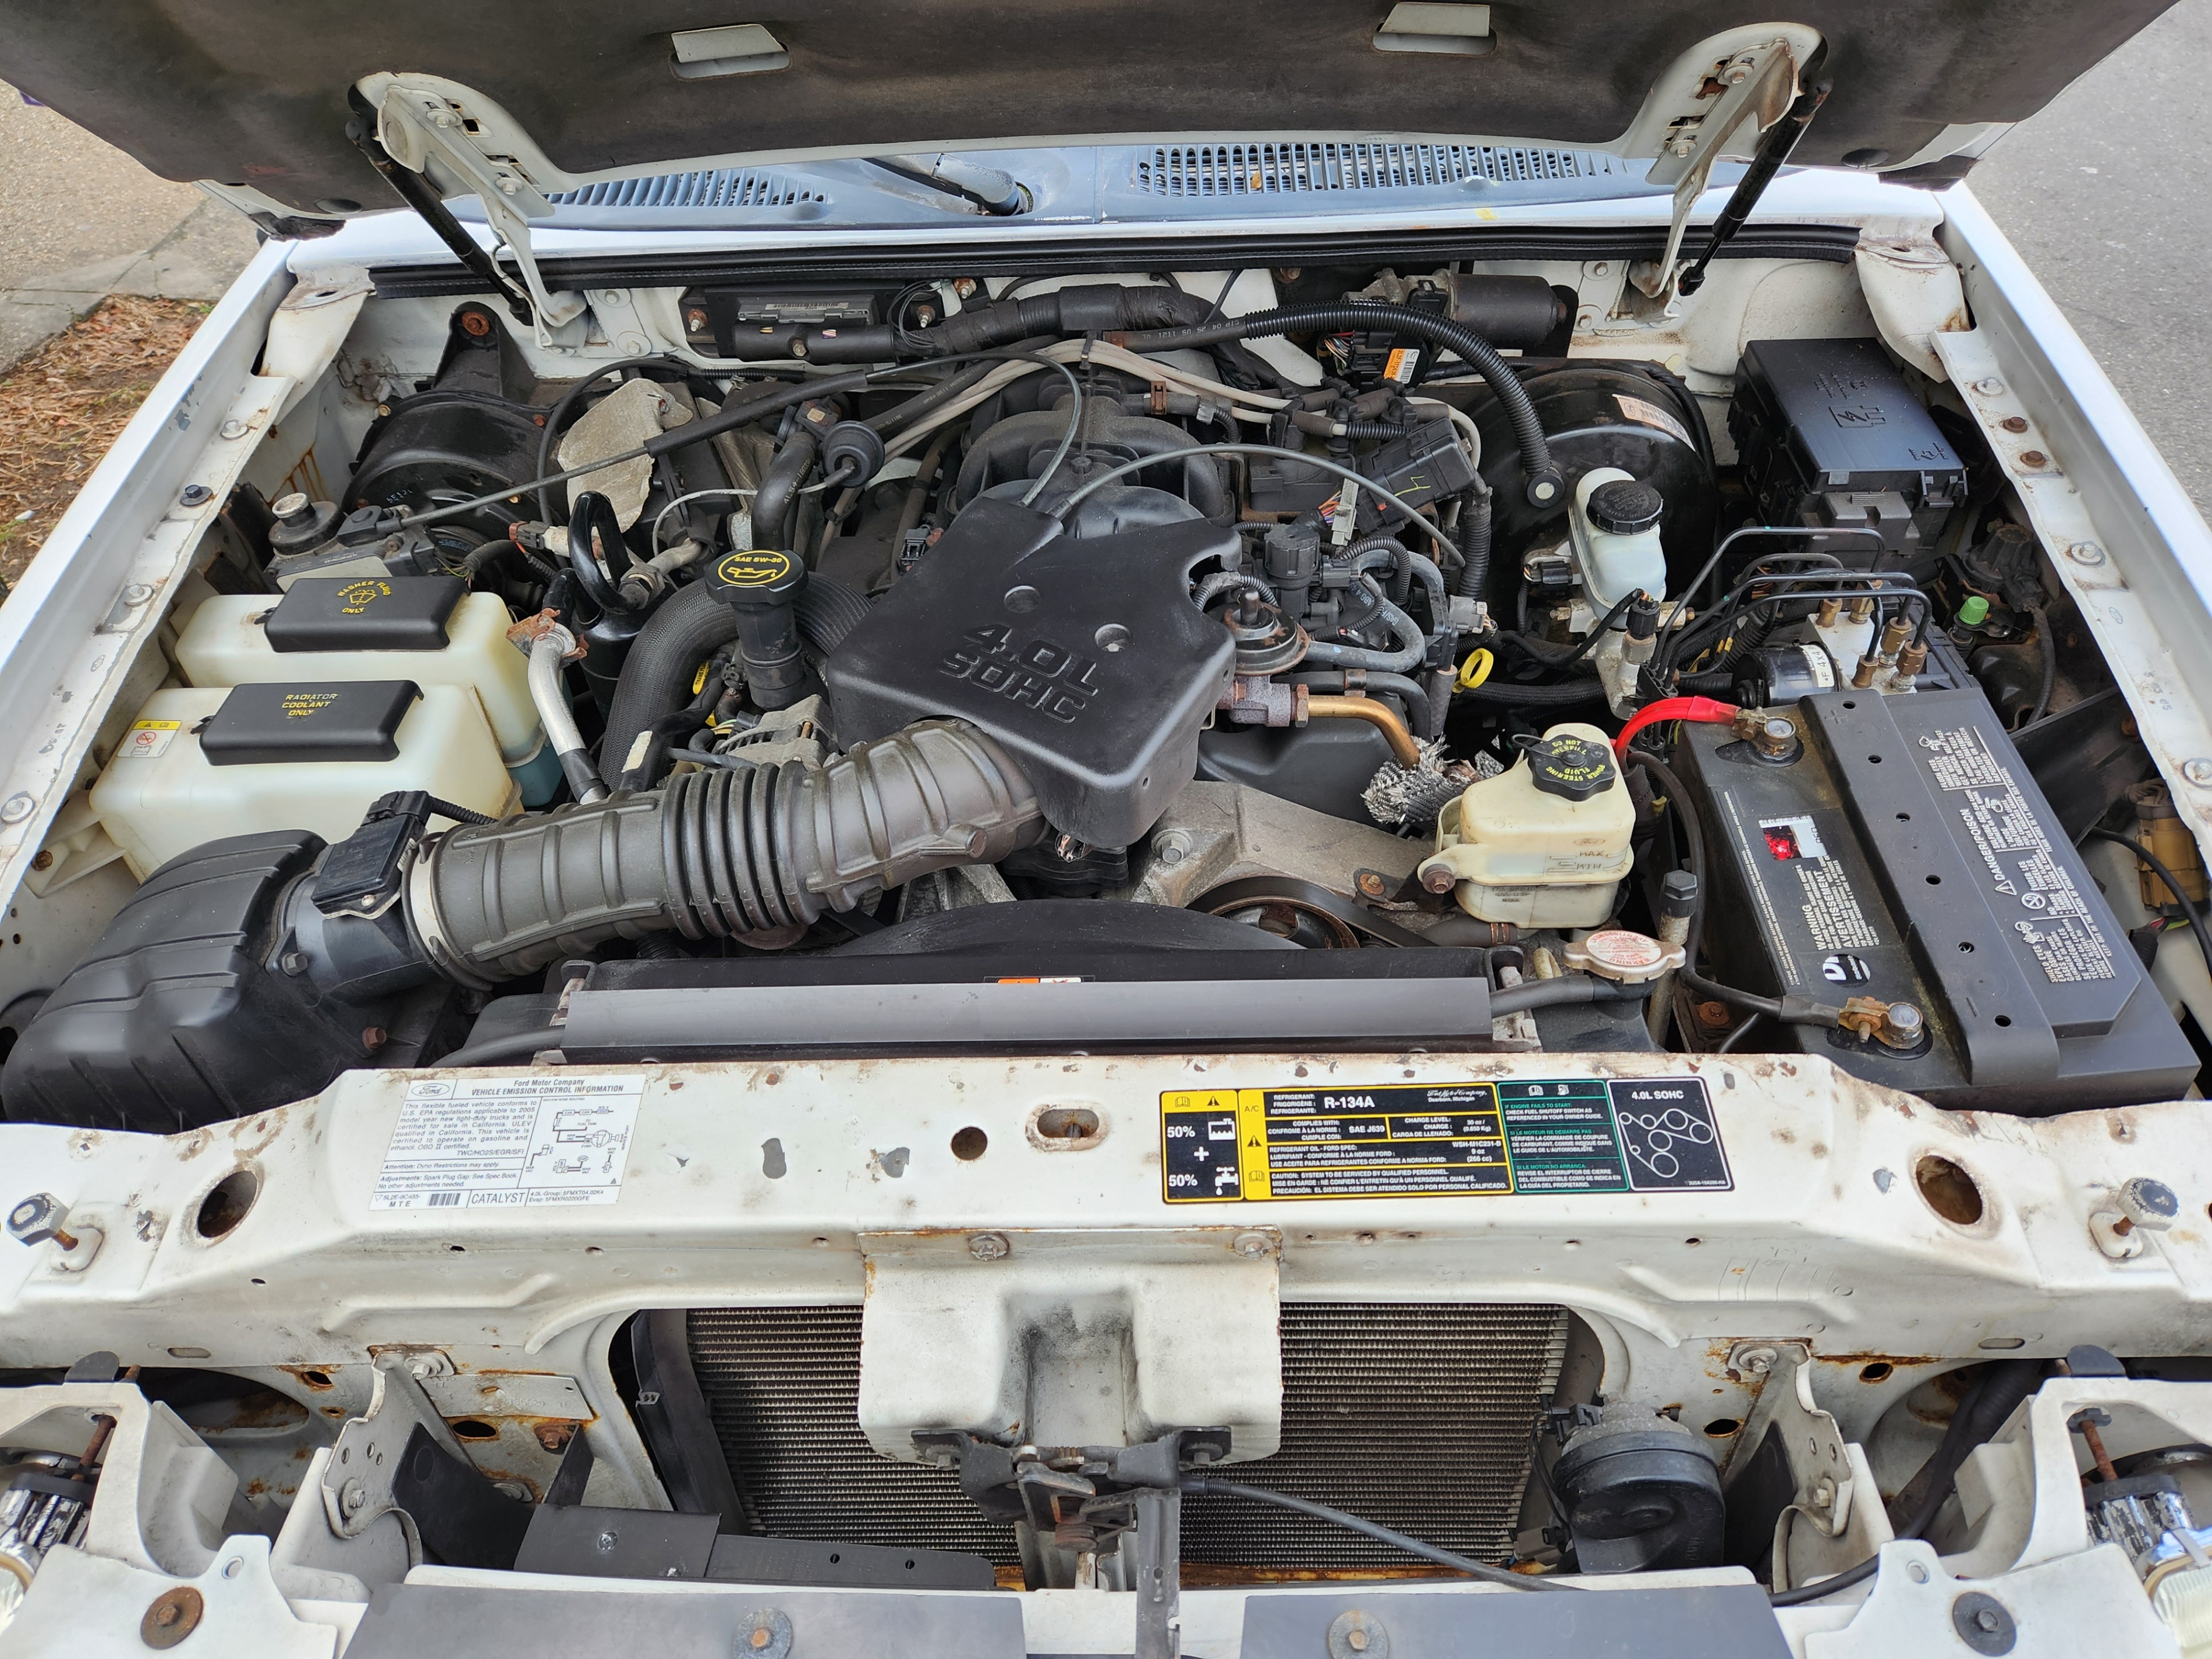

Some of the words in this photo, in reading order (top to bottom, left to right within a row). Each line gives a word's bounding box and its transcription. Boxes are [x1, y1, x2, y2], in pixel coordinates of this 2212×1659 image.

[337, 581, 374, 597] WASHER
[377, 582, 391, 595] FLUID
[962, 623, 1099, 697] 4.0L
[935, 648, 1086, 723] SOHC
[1586, 764, 1605, 779] POWER
[1927, 759, 1939, 771] EYES
[1546, 766, 1583, 781] STEERING
[1934, 772, 1948, 788] FLUSH
[1958, 809, 2005, 881] DANGER/POISON
[1813, 870, 1853, 947] AVERTISSEMENT
[1801, 904, 1827, 950] WARNING
[2031, 944, 2046, 960] EYES
[2041, 962, 2058, 982] SHIELD
[419, 1086, 442, 1094] Ford
[1632, 1090, 1653, 1100] 4.0L
[1654, 1090, 1684, 1100] SOHC
[1324, 1096, 1375, 1108] R-134A
[1167, 1126, 1196, 1137] 50%
[1169, 1174, 1198, 1186] 50%
[472, 1193, 526, 1204] CATALYST
